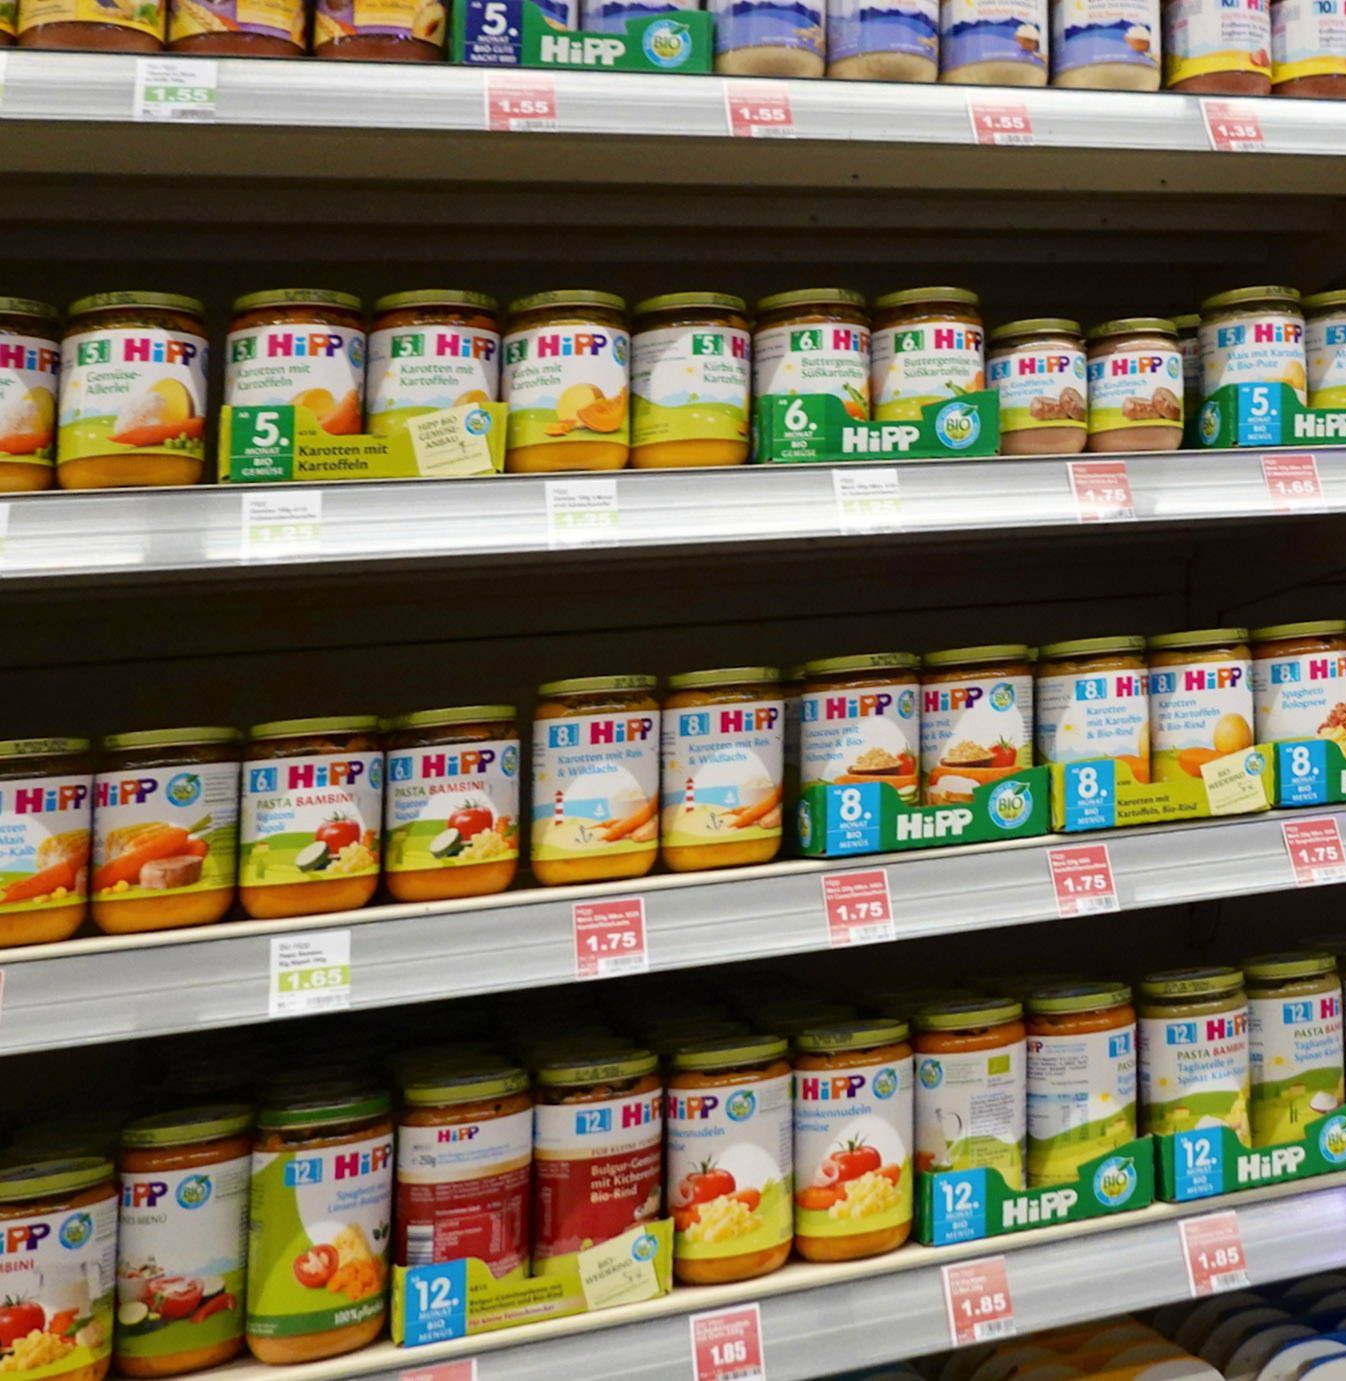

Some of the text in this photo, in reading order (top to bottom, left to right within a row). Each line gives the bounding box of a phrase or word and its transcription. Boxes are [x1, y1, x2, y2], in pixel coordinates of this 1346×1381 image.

[481, 2, 518, 37] 5.
[540, 35, 626, 66] HiPP
[652, 37, 681, 51] BIO
[153, 88, 209, 103] 1.55
[498, 100, 549, 114] 1.55
[738, 107, 786, 122] 1.55
[981, 115, 1026, 130] 1.55
[1216, 124, 1258, 138] 1.35
[123, 338, 197, 366] HiPP
[267, 333, 343, 358] HiPP
[436, 333, 497, 361] HiPP
[537, 333, 608, 358] HiPP
[289, 364, 311, 375] mit
[400, 363, 475, 376] Karotten mit
[1018, 356, 1070, 375] HiPP
[1111, 356, 1163, 377] HiPP
[86, 371, 142, 385] Gemüse-
[235, 376, 294, 391] Kartoffeln
[400, 374, 460, 388] Kartoffeln
[85, 382, 131, 396] Allerlei
[1251, 386, 1278, 416] 5.
[785, 399, 818, 431] 6.
[251, 412, 290, 448] 5.
[946, 416, 971, 432] BIO
[790, 441, 808, 449] BIO
[842, 425, 920, 453] HiPP
[244, 447, 281, 456] MONAT
[298, 443, 389, 458] Karotten mit
[253, 458, 274, 467] BIO
[298, 457, 369, 473] Kartoffeln
[241, 466, 284, 477] GEMÜSE
[1086, 488, 1128, 504] 1.75
[1275, 480, 1315, 495] 1.65
[1184, 666, 1243, 692] HiPP
[925, 687, 983, 712] HiPP
[1281, 686, 1324, 700] Spaghetti
[826, 693, 893, 720] HiPP
[1086, 703, 1127, 715] Karotten
[1281, 697, 1327, 710] Bolognese
[720, 707, 779, 734] HiPP
[589, 717, 654, 745] HiPP
[688, 741, 733, 754] Karotten
[421, 749, 496, 779] HiPP
[557, 749, 627, 765] Karotten mit
[699, 750, 748, 765] Wildlachs
[1290, 746, 1320, 777] 8.
[288, 760, 364, 791] HiPP
[568, 762, 619, 778] Wildlachs
[1077, 766, 1108, 799] 8.
[15, 784, 88, 815] HiPP
[395, 784, 427, 799] PASTA
[256, 796, 292, 810] PASTA
[839, 787, 872, 821] 8.
[998, 796, 1024, 811] BIO
[1117, 794, 1170, 808] Karotten mit
[896, 808, 974, 842] HiPP
[1298, 846, 1339, 863] 1.75
[1063, 875, 1107, 892] 1.75
[836, 901, 884, 921] 1.75
[586, 931, 637, 952] 1.75
[286, 968, 343, 991] 1.65
[1293, 1027, 1324, 1039] PASTA
[1177, 1048, 1210, 1061] PASTA
[801, 1075, 866, 1102] HiPP
[437, 1126, 480, 1142] HiPP
[1181, 1137, 1218, 1168] 12.
[334, 1142, 392, 1181] HiPP
[1237, 1145, 1307, 1184] HiPP
[1101, 1173, 1128, 1189] BIO
[590, 1184, 638, 1203] Bio-Rind
[942, 1181, 980, 1213] 12.
[1002, 1188, 1078, 1229] HiPP
[1198, 1246, 1240, 1271] 1.85
[415, 1276, 459, 1311] 12.
[961, 1292, 1007, 1318] 1.85
[426, 1319, 446, 1329] BIO
[710, 1340, 748, 1365] 1.85
